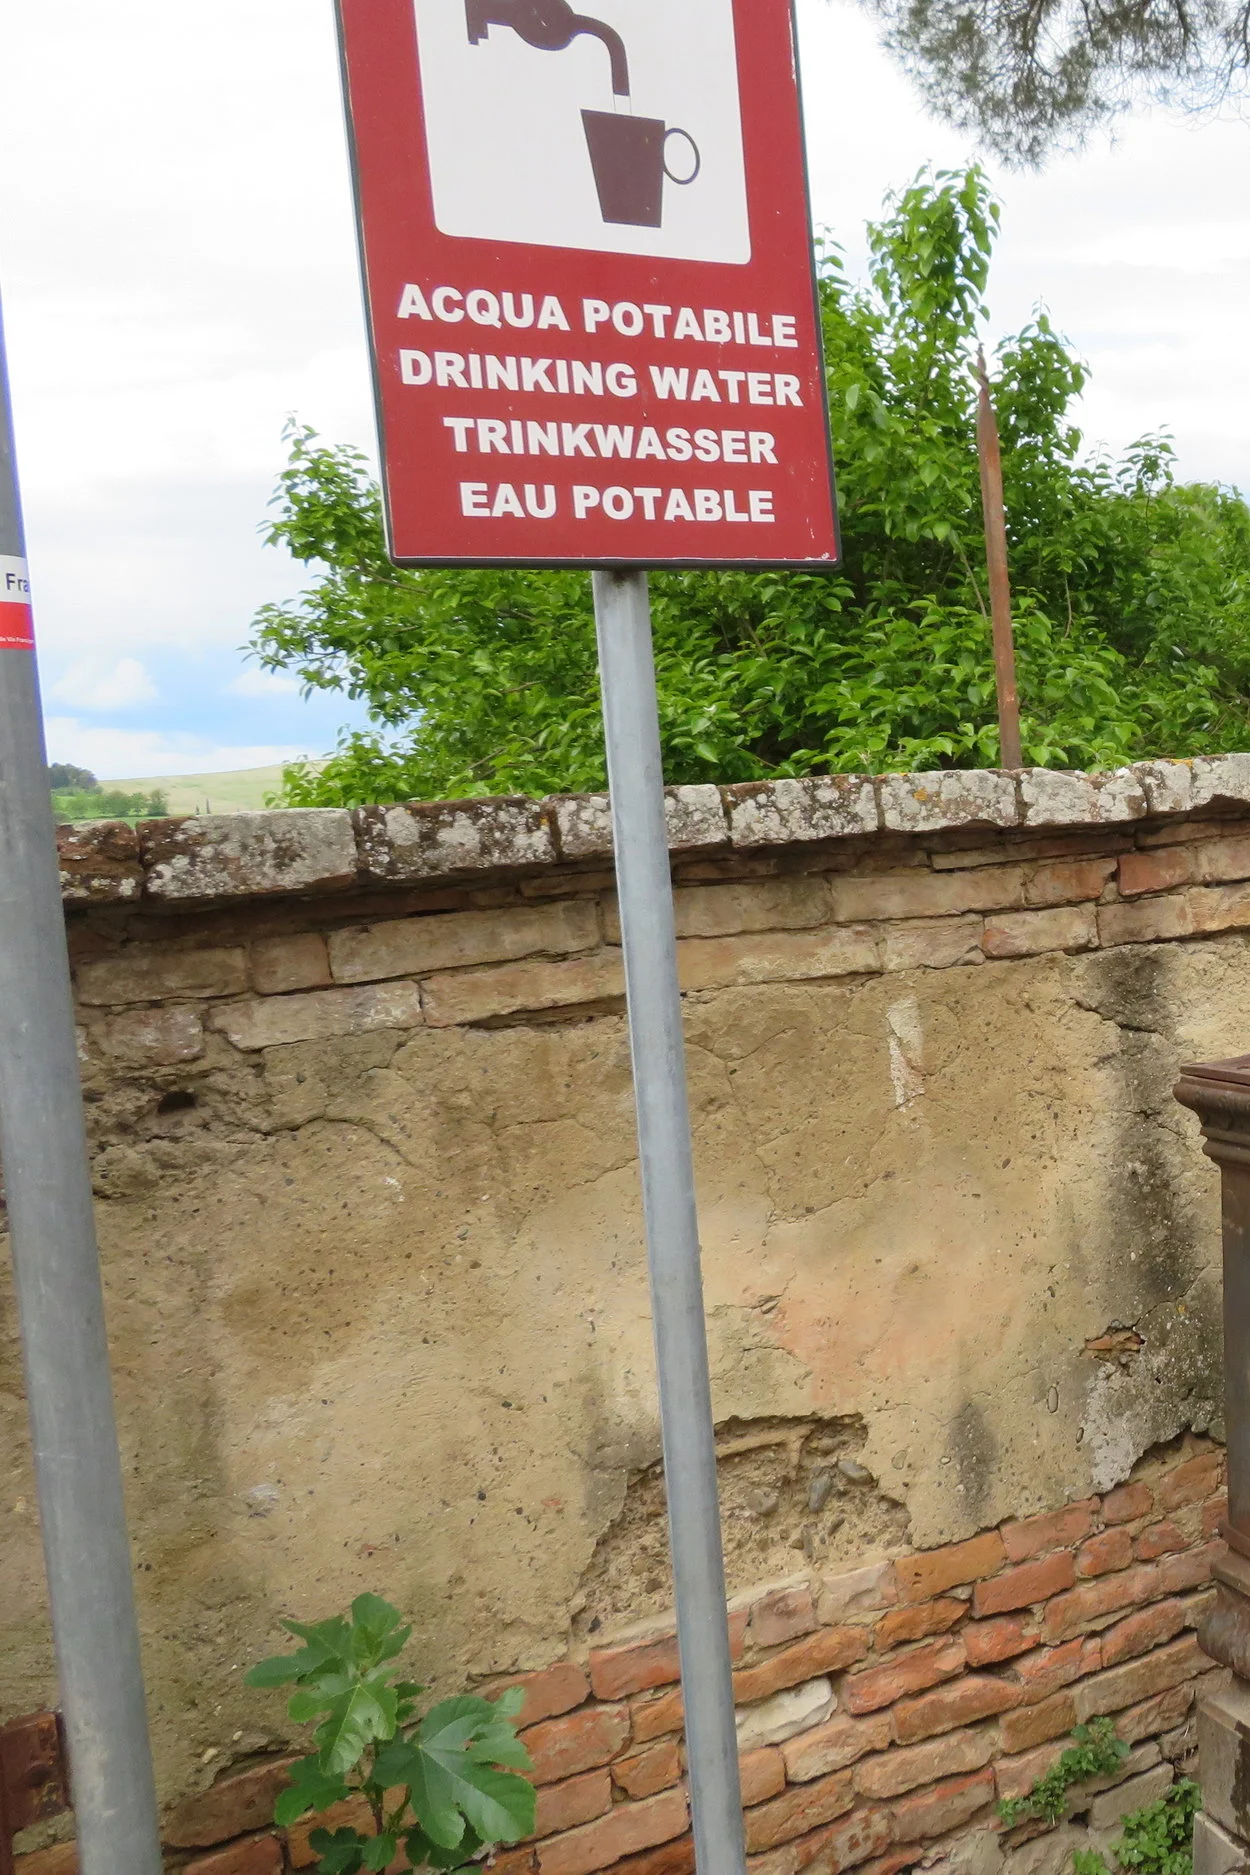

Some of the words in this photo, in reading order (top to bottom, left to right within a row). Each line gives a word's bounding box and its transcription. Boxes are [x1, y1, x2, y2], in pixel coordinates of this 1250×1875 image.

[396, 283, 571, 331] ACQUA
[582, 298, 799, 348] POTABILE
[399, 348, 638, 398] DRINKING
[648, 365, 804, 407] WATER
[442, 416, 779, 464] TRINKWASSER
[459, 481, 557, 519] EAU
[572, 485, 776, 523] POTABLE
